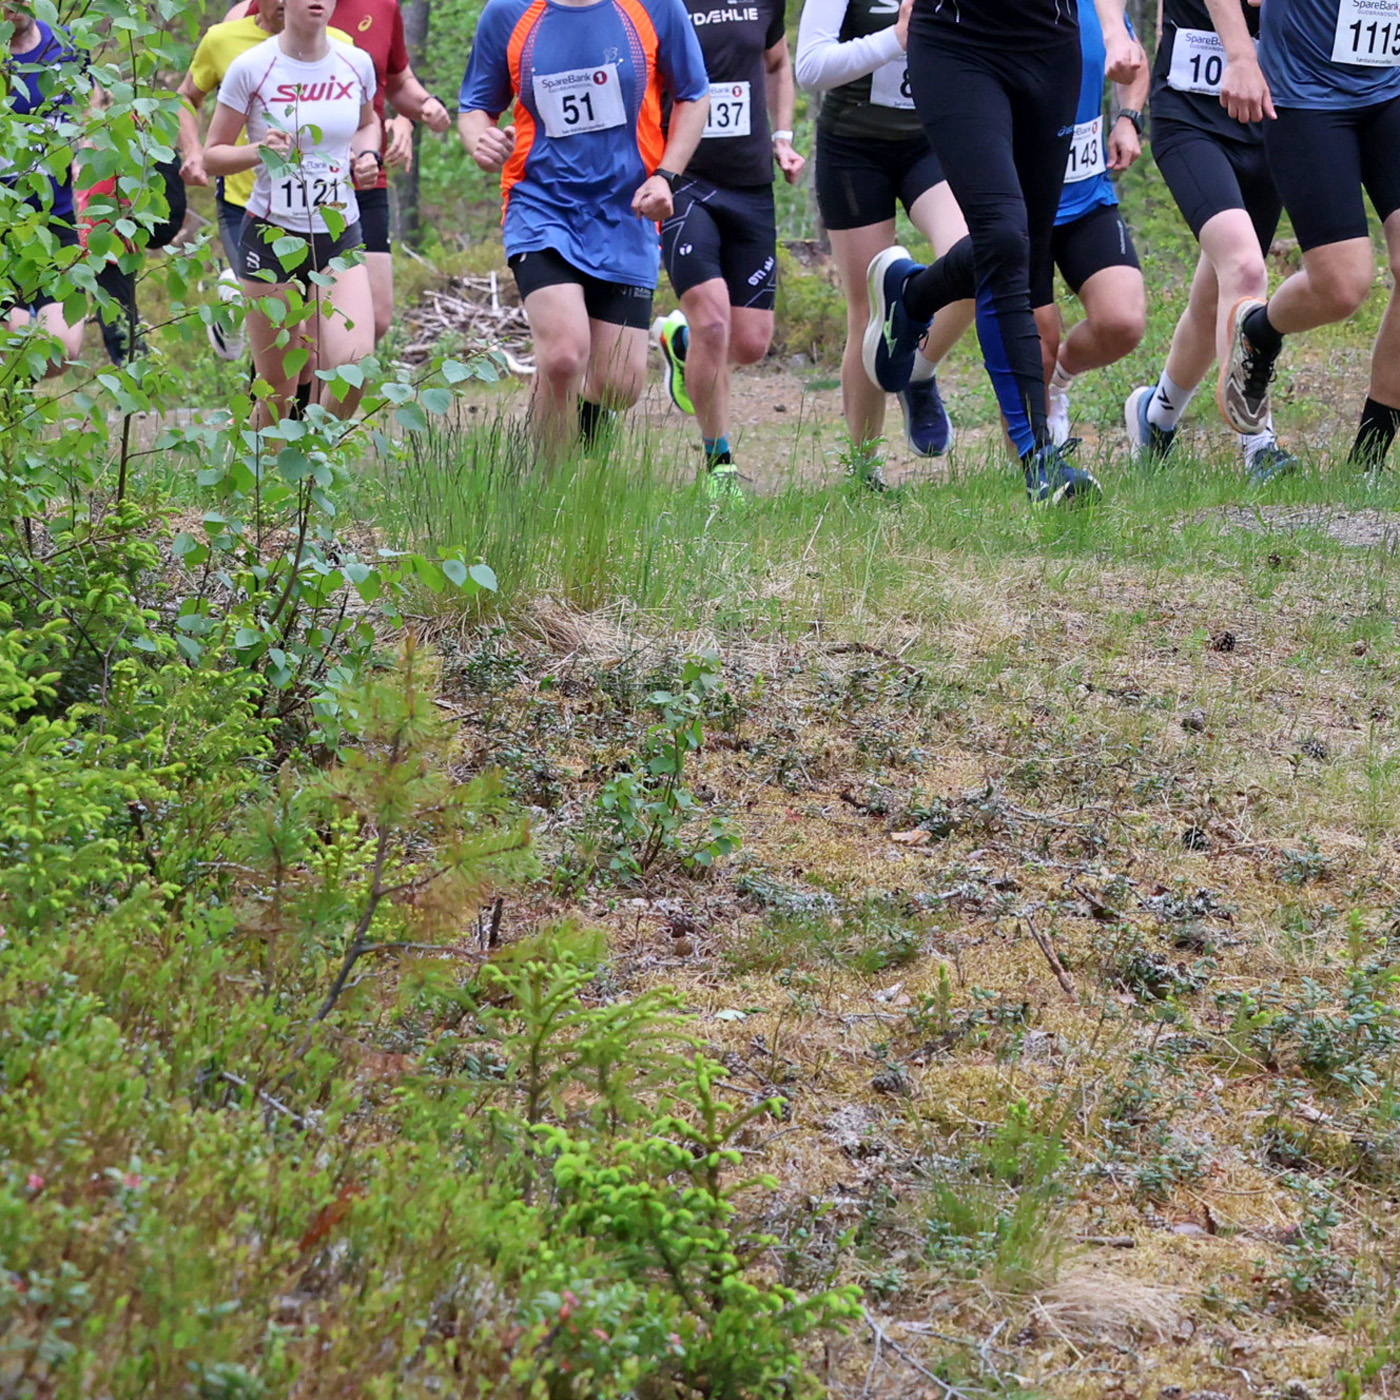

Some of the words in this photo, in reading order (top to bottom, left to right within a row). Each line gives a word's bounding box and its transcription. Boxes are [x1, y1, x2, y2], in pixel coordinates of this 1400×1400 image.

[693, 7, 760, 26] DÆHLIE
[1185, 32, 1222, 46] SpareB
[541, 72, 592, 89] SpareBank
[562, 91, 594, 125] 51
[1068, 138, 1098, 172] 143
[281, 178, 339, 208] 1121
